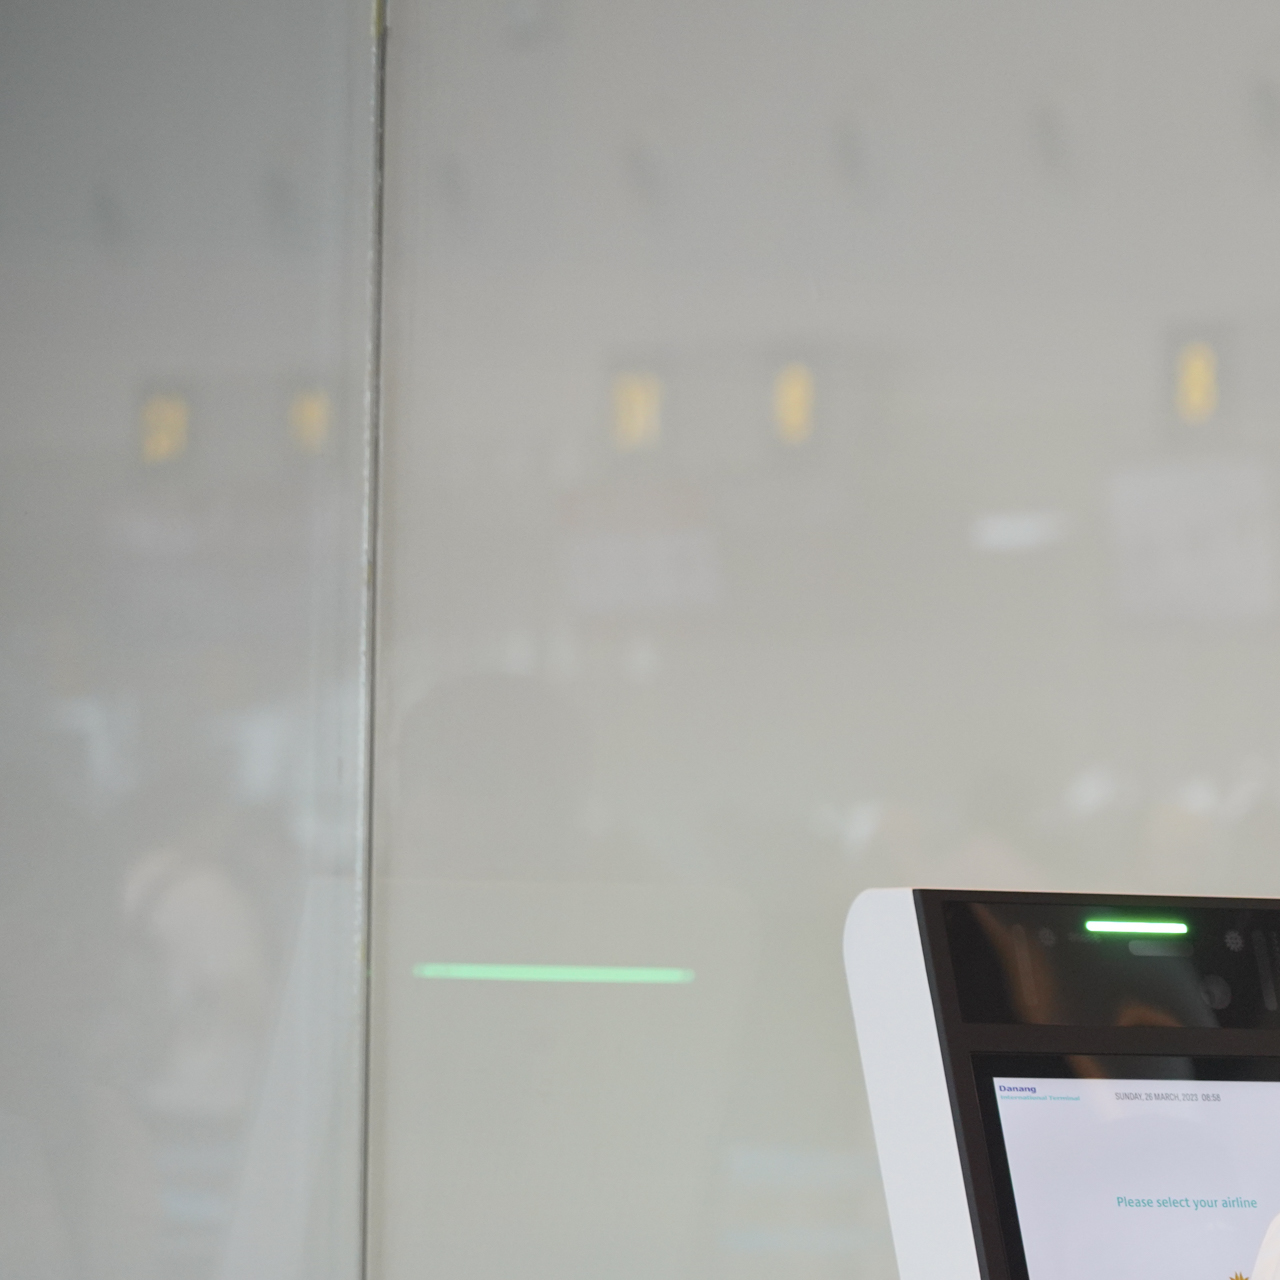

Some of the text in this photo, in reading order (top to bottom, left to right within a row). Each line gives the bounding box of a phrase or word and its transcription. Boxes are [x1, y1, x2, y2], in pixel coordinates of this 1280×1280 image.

[999, 1085, 1037, 1093] Danang
[1116, 1196, 1258, 1211] Please select your airline
